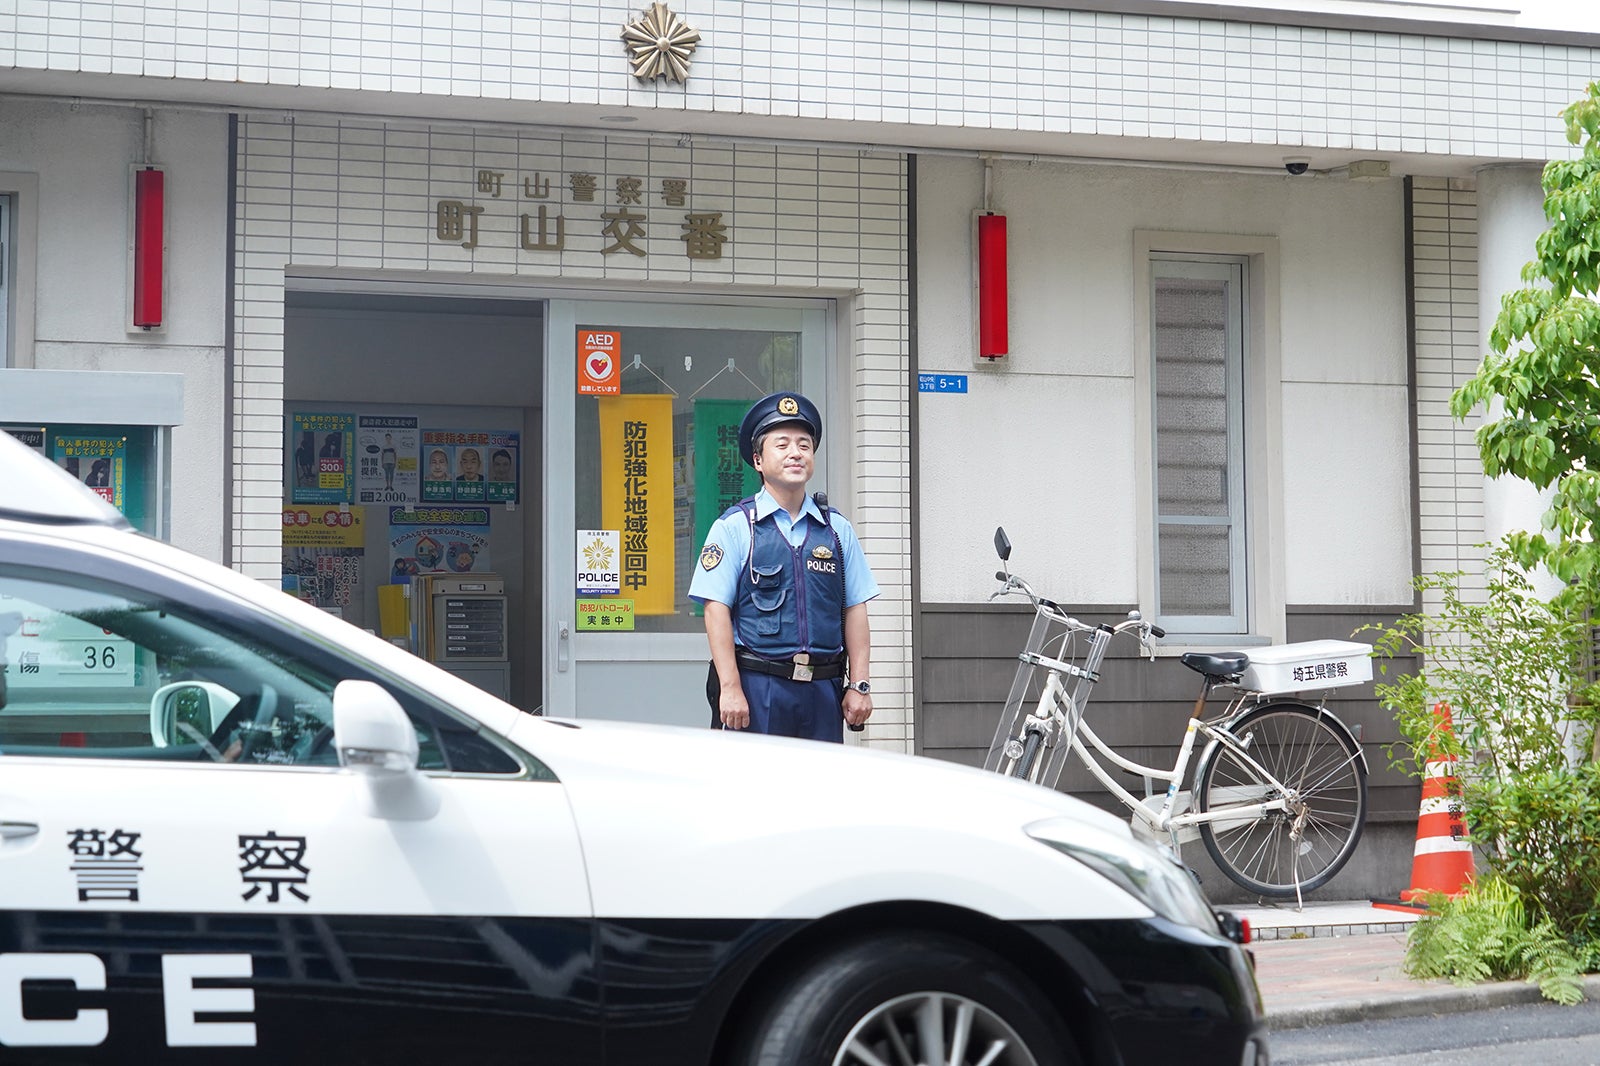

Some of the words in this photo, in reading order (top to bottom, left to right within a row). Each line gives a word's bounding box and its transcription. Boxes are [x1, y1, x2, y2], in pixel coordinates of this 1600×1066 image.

[478, 170, 687, 206] 町山警察署
[437, 201, 728, 259] 町山交番
[586, 334, 614, 346] AED
[940, 378, 961, 389] 5-1
[320, 463, 340, 472] 300
[623, 421, 648, 591] 防犯強化地域巡回中
[807, 560, 836, 573] POLICE
[578, 573, 618, 582] POLICE
[580, 603, 631, 612] 防犯パトロール
[587, 615, 624, 625] 実施中
[84, 646, 116, 669] 36
[1293, 662, 1348, 682] 埼玉県警察
[67, 828, 311, 903] 警察
[0, 952, 258, 1047] CE
